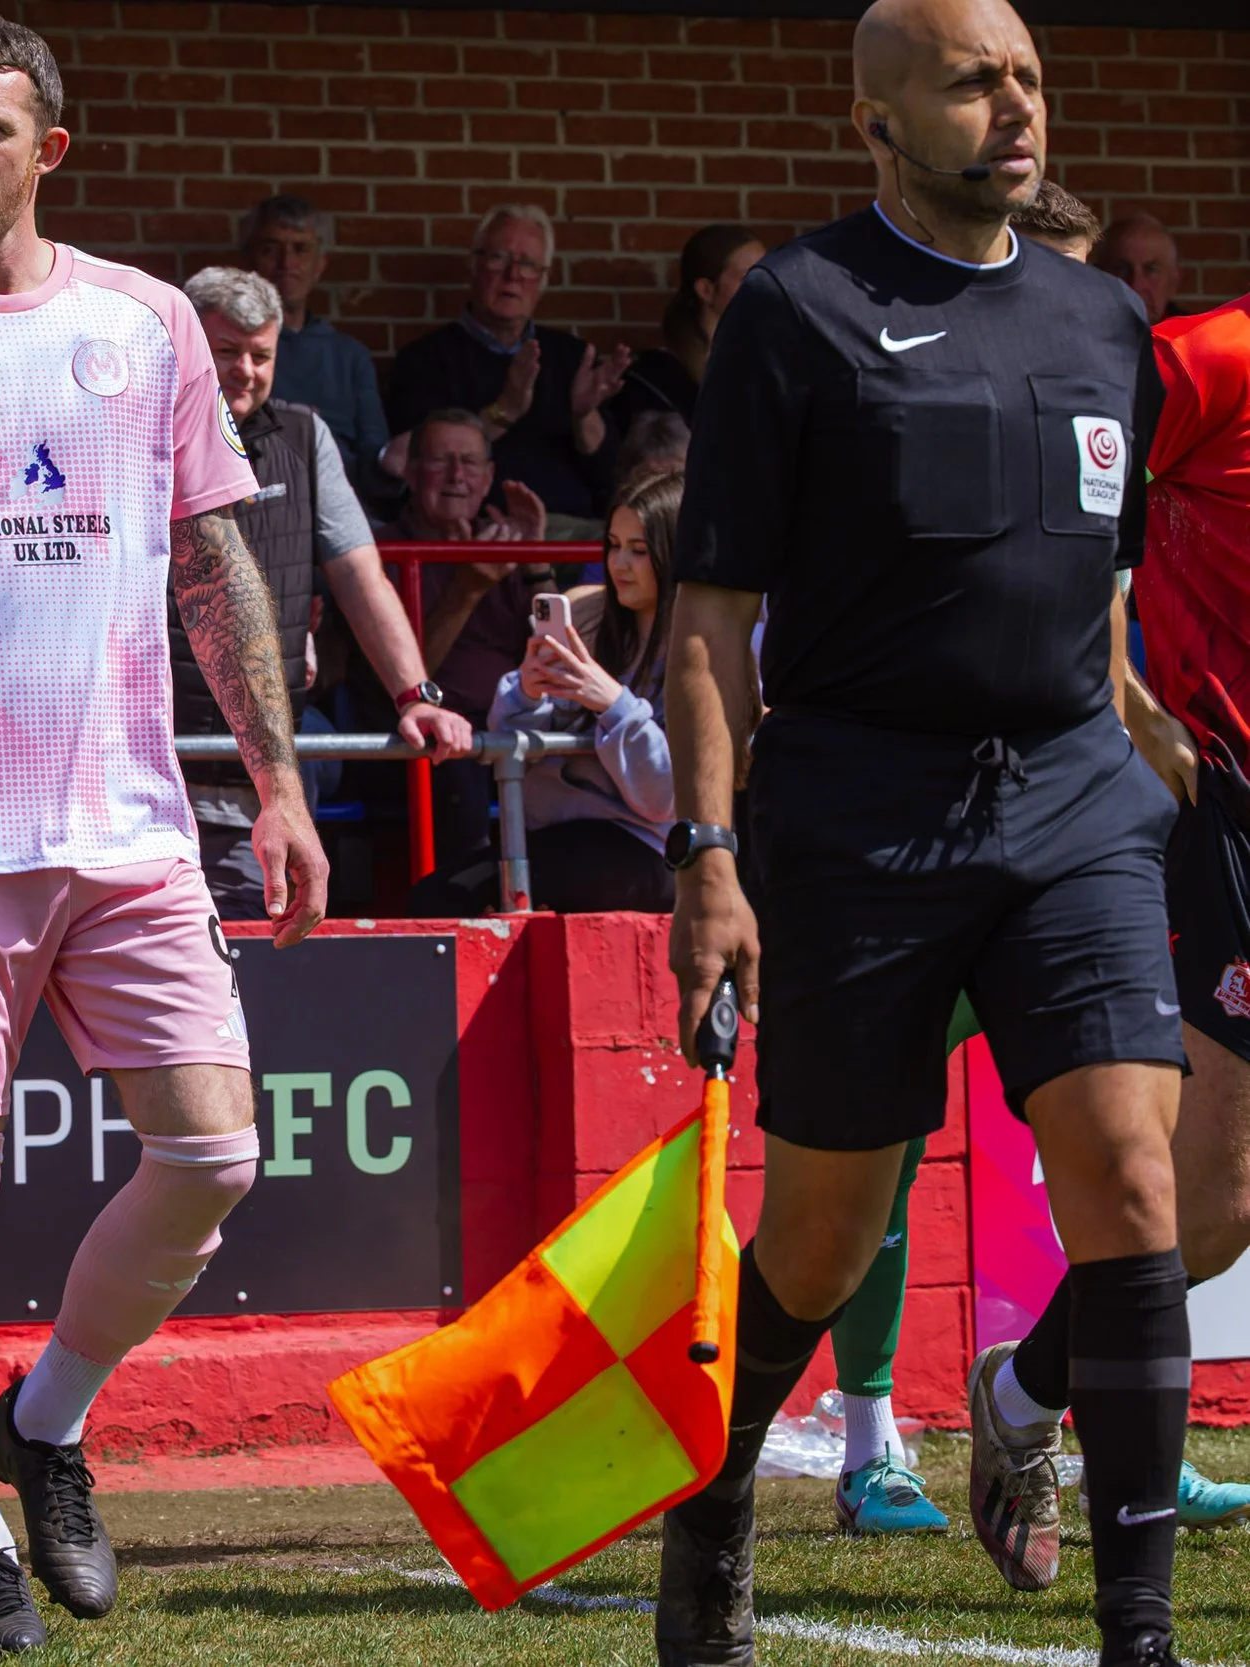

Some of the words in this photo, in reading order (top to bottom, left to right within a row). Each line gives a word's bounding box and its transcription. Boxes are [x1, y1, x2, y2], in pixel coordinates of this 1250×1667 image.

[1083, 477, 1121, 491] NATIONAL
[1087, 487, 1117, 501] LEAGUE
[53, 514, 111, 534] STEELS
[13, 542, 40, 562] UK
[44, 541, 82, 560] LTD.
[262, 1069, 413, 1177] FC
